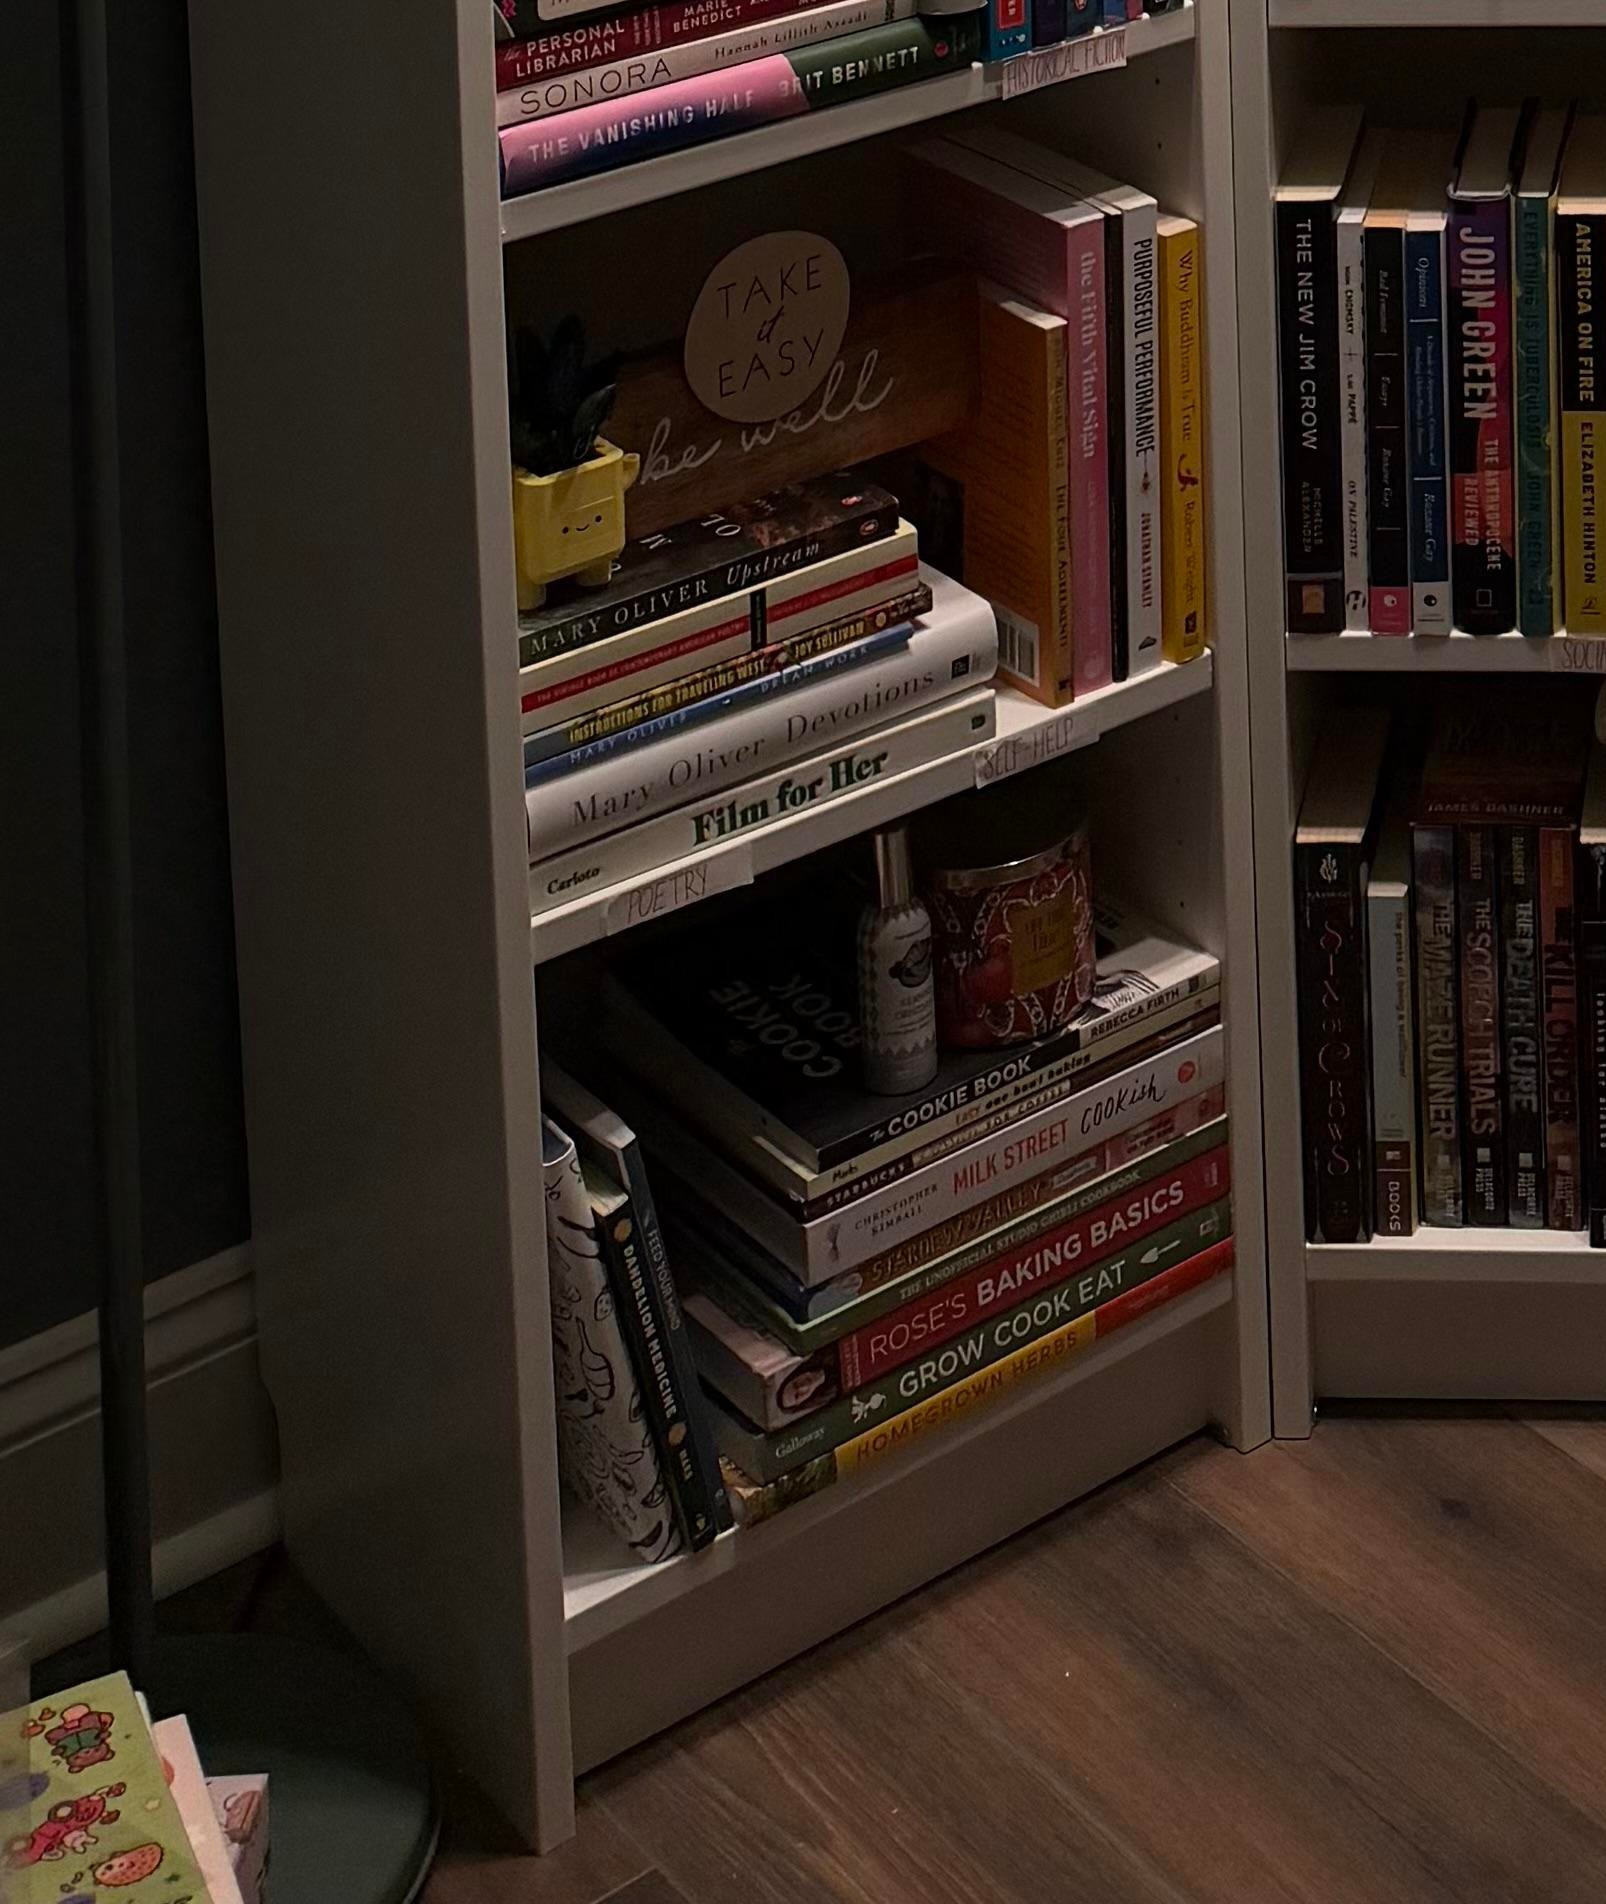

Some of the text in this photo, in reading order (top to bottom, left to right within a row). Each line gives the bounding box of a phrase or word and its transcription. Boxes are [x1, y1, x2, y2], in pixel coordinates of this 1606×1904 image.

[519, 58, 674, 114] SONORA
[718, 255, 822, 319] TAKE
[1297, 219, 1318, 451] THE NEW JIM CROW
[718, 328, 825, 398] EASY
[529, 541, 821, 655] MARY OLIVER Upstream
[569, 667, 935, 828] Mary Oliver Devotions
[692, 750, 888, 847] Film for Her
[951, 1119, 1069, 1197] MILK STREET
[868, 1181, 1186, 1364] ROSE'S BAKING BASICS
[898, 1260, 1127, 1398] GROW COOK EAT
